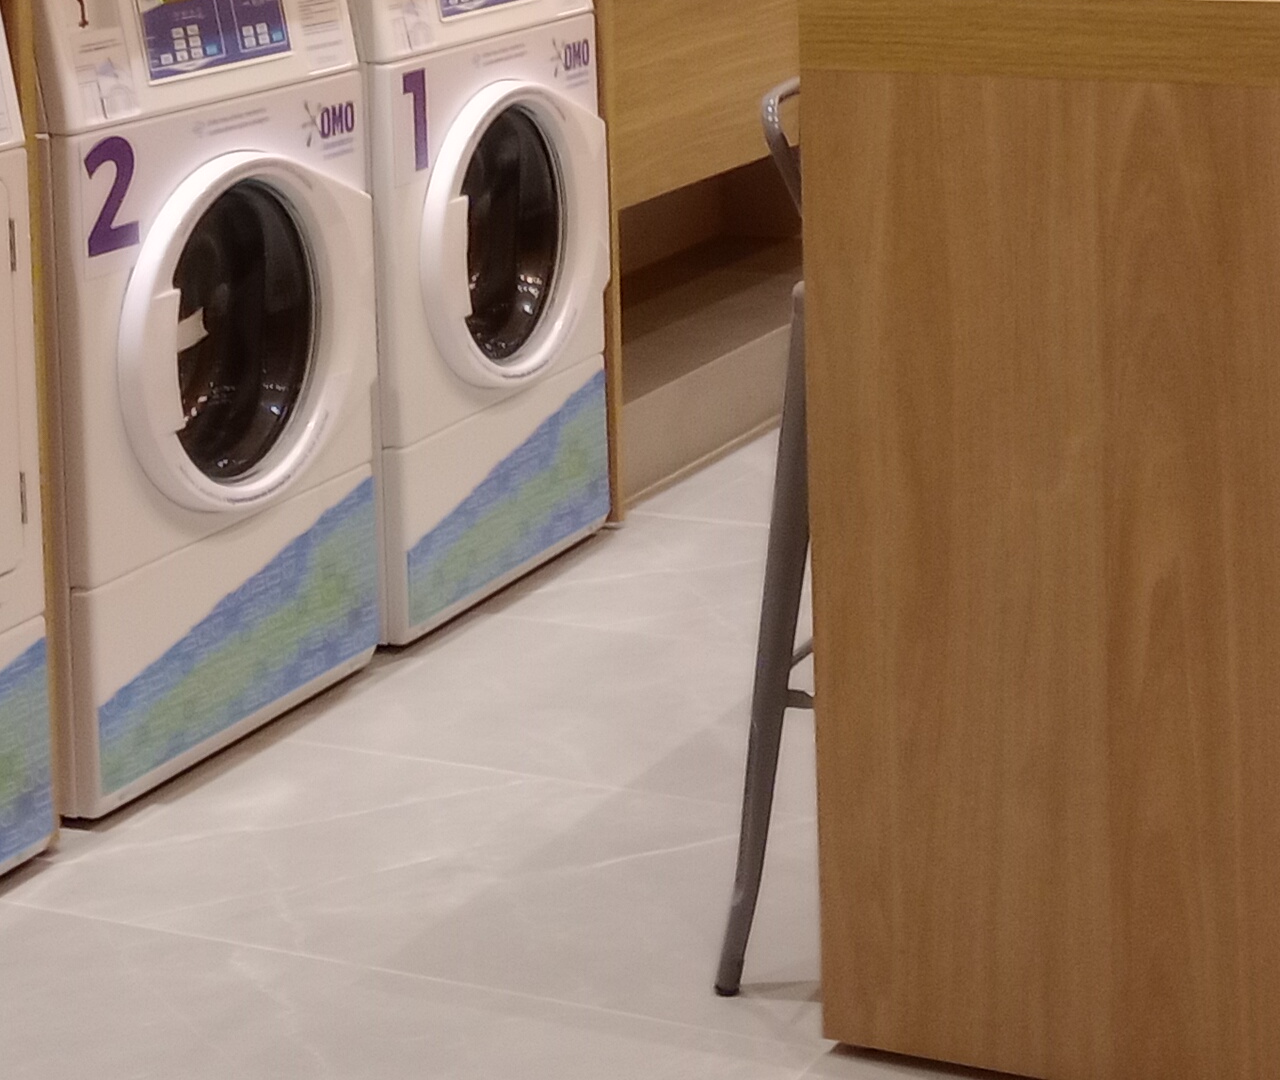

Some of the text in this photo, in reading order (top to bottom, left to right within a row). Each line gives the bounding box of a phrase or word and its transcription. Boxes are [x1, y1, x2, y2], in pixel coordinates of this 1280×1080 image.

[564, 38, 590, 71] OMO
[320, 101, 355, 139] OMO
[402, 67, 429, 172] 1
[83, 135, 140, 257] 2
